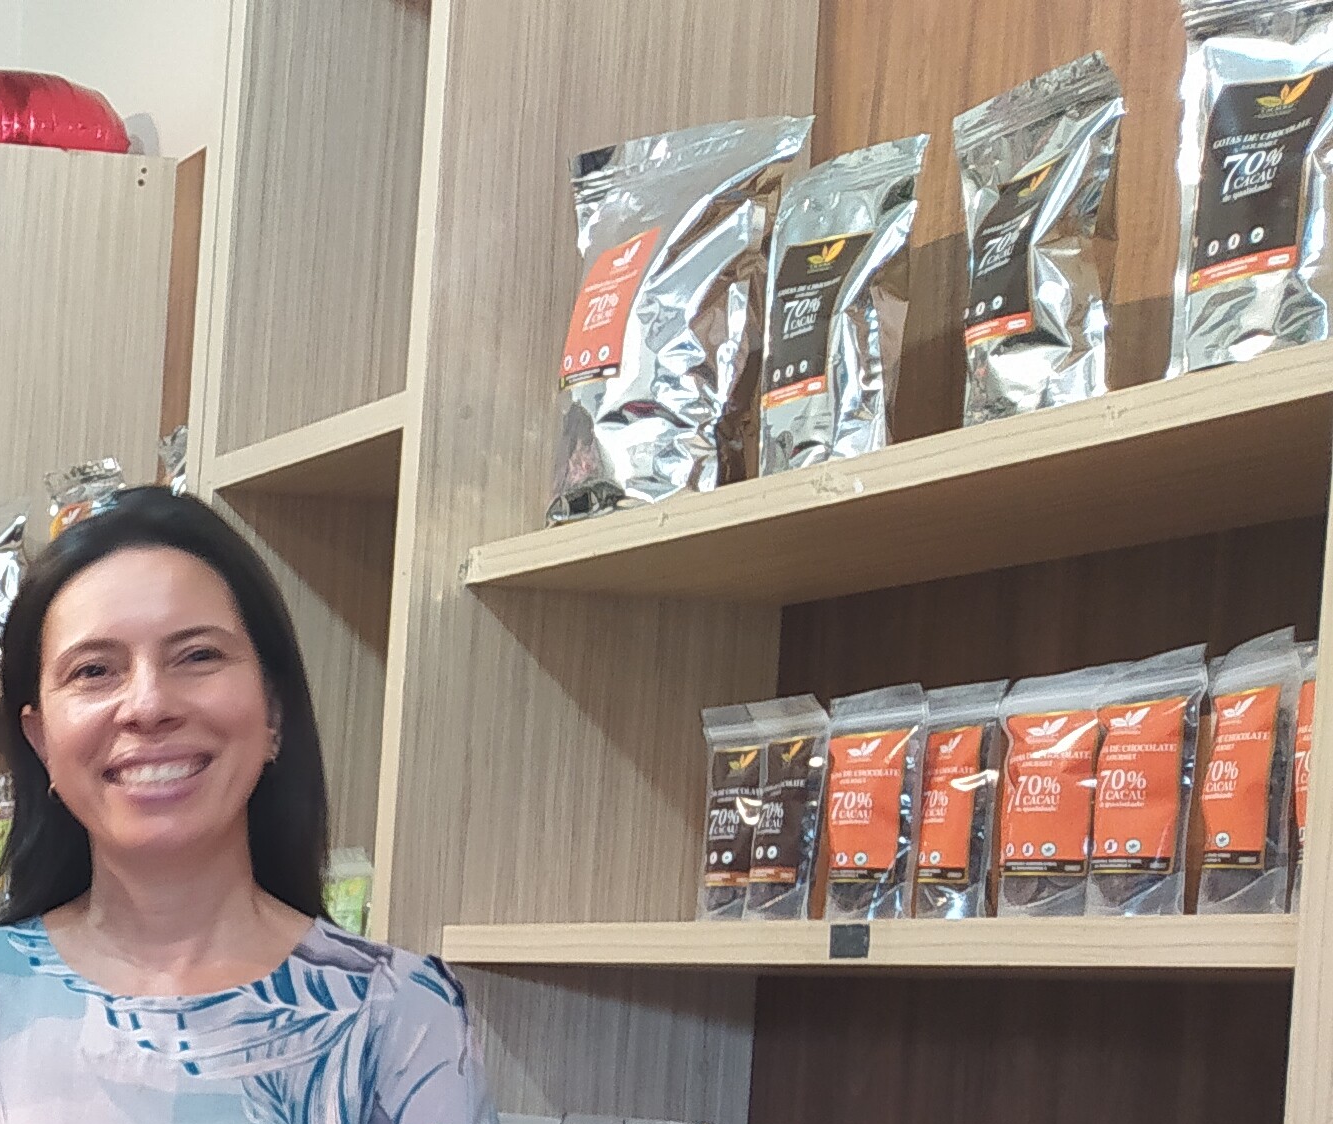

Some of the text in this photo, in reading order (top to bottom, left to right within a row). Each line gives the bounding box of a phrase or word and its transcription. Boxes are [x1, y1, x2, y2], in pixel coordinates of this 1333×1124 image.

[1222, 146, 1285, 195] 70%
[1233, 167, 1277, 189] CACAU
[783, 296, 822, 334] 70%
[1015, 774, 1061, 806] 70%
[1099, 769, 1147, 801] 70%
[1105, 790, 1147, 801] CACAU
[831, 791, 873, 820] 70%
